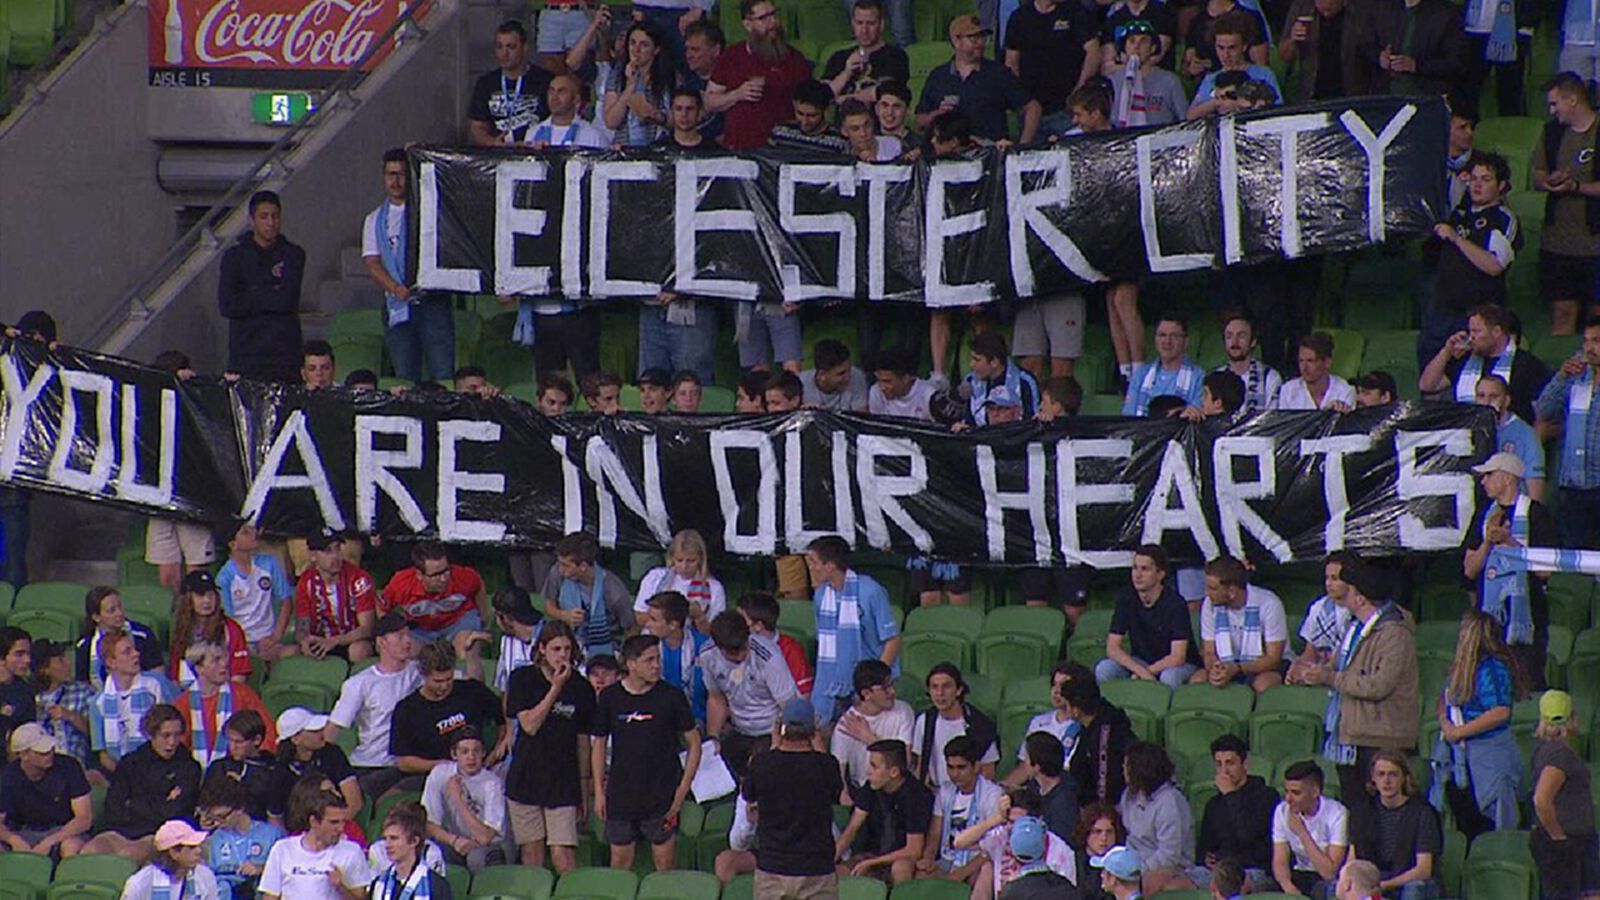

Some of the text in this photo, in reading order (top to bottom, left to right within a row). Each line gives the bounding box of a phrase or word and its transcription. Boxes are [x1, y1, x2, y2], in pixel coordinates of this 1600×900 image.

[153, 71, 211, 87] AISLE 15
[194, 0, 386, 65] Coca-Cola
[416, 103, 1418, 308] LEICESTER CITY
[0, 353, 1476, 568] YOU ARE IN OUR HEARTS
